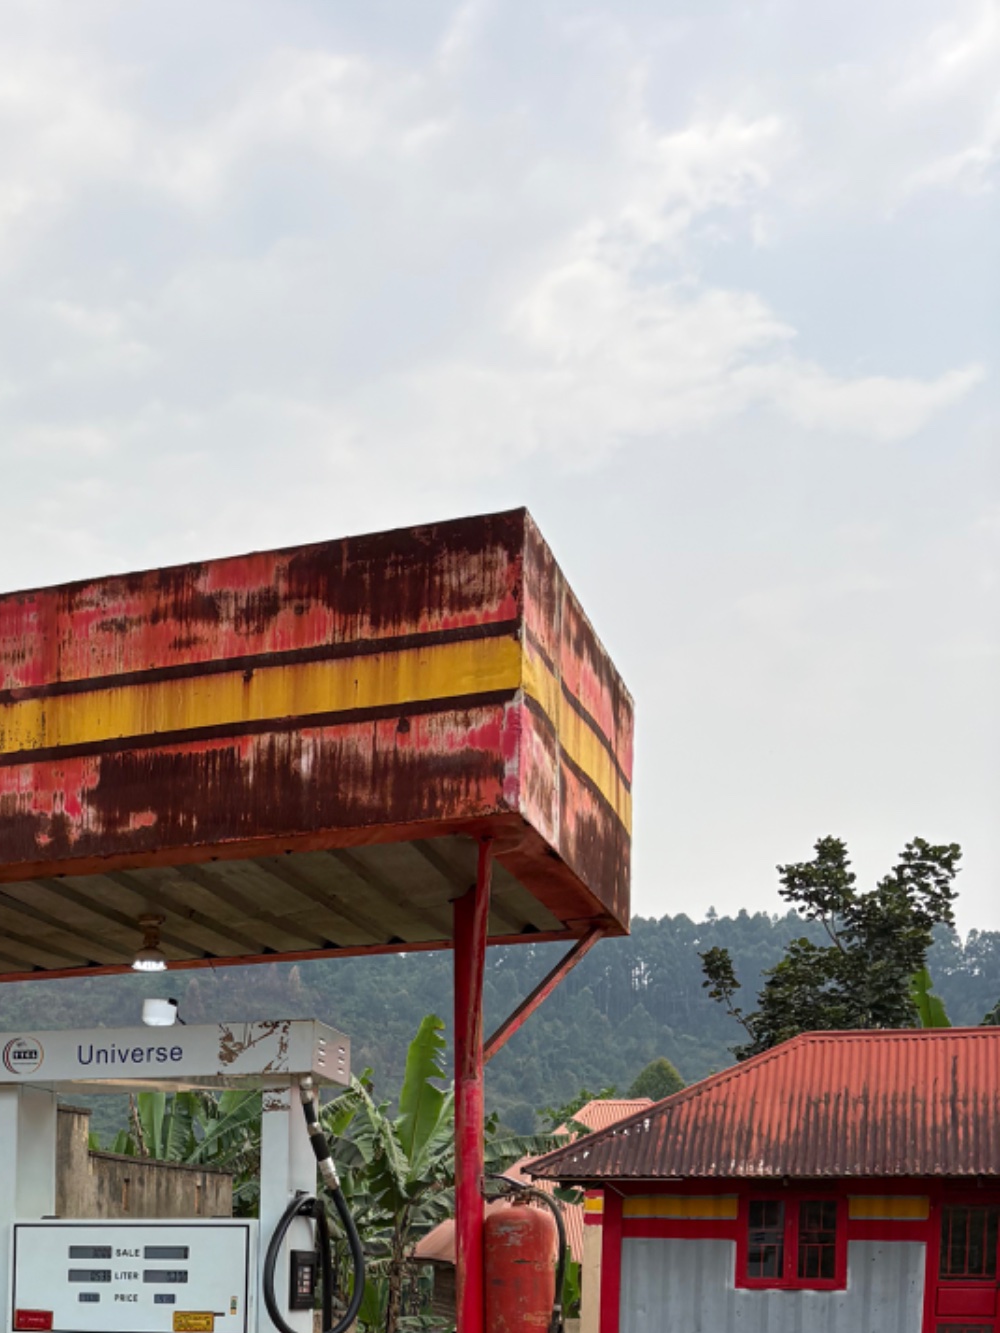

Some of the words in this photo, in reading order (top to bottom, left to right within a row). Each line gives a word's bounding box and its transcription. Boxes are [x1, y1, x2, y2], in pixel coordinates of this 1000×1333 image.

[78, 1044, 183, 1065] Universe
[115, 1248, 140, 1258] SALE
[114, 1271, 139, 1281] LITER
[114, 1294, 138, 1303] PRICE
